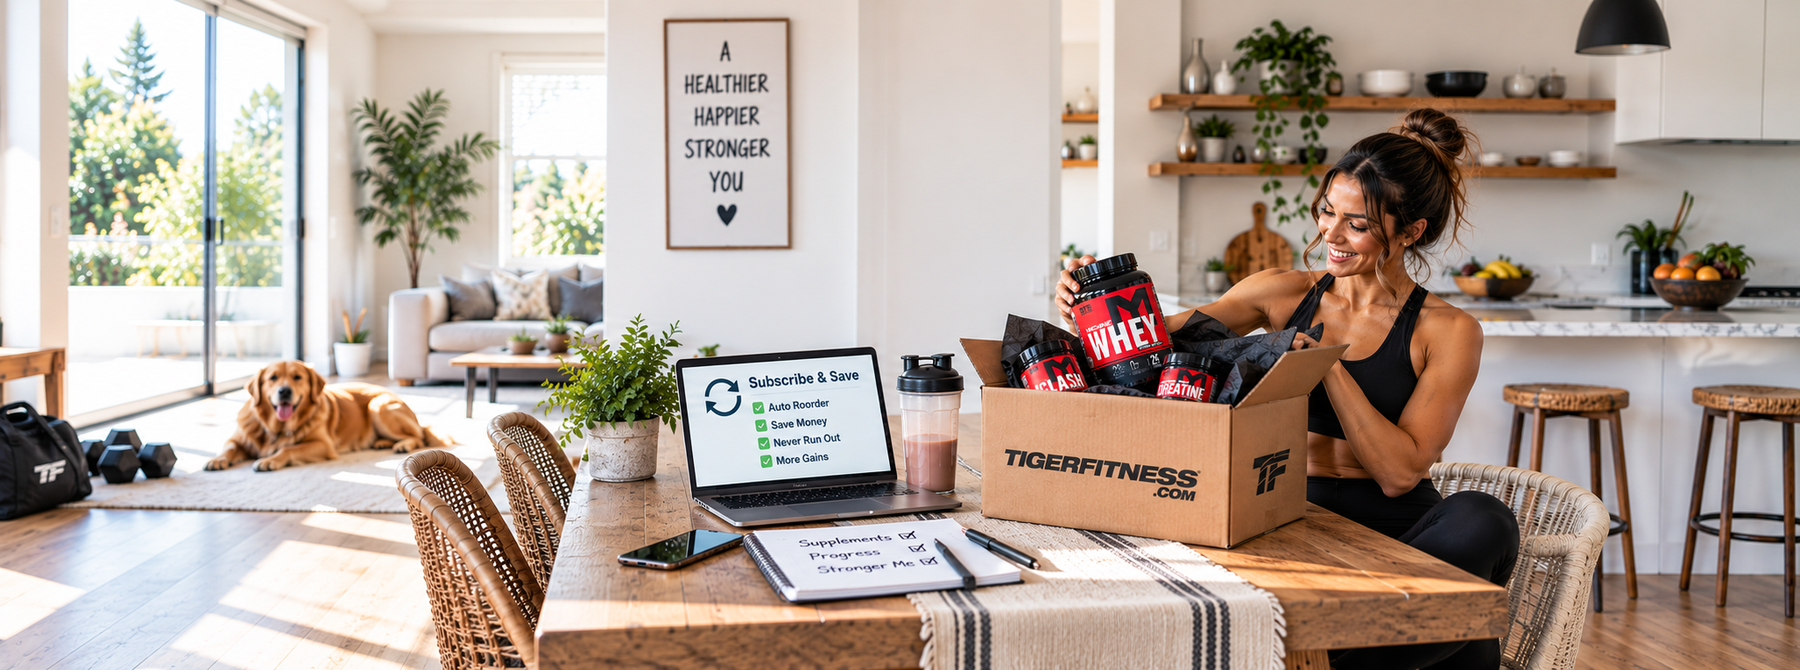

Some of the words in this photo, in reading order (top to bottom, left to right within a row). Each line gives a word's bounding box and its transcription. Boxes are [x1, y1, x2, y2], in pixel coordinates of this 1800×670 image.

[720, 41, 731, 62] A
[684, 73, 769, 95] HEALTHIER
[694, 105, 760, 127] HAPPIER
[685, 138, 770, 159] STRONGER
[709, 170, 744, 193] YOU
[1087, 313, 1159, 361] WHEY
[749, 373, 814, 388] Subscribe
[817, 371, 827, 383] &
[829, 370, 860, 382] Save
[768, 402, 791, 412] Auto
[793, 399, 830, 410] Roorder
[771, 420, 794, 430] Save
[796, 418, 827, 428] Money
[773, 438, 801, 448] Never
[803, 435, 822, 445] Run
[823, 433, 841, 443] Out
[776, 456, 800, 465] More
[802, 453, 829, 463] Gains
[34, 460, 66, 484] TF
[1005, 449, 1199, 489] TIGERFITNESS
[1252, 448, 1291, 497] TF
[1152, 486, 1196, 502] .COM
[798, 534, 893, 549] Supplements
[809, 549, 881, 561] Progress
[817, 562, 888, 574] Stronger
[892, 560, 916, 568] Me
